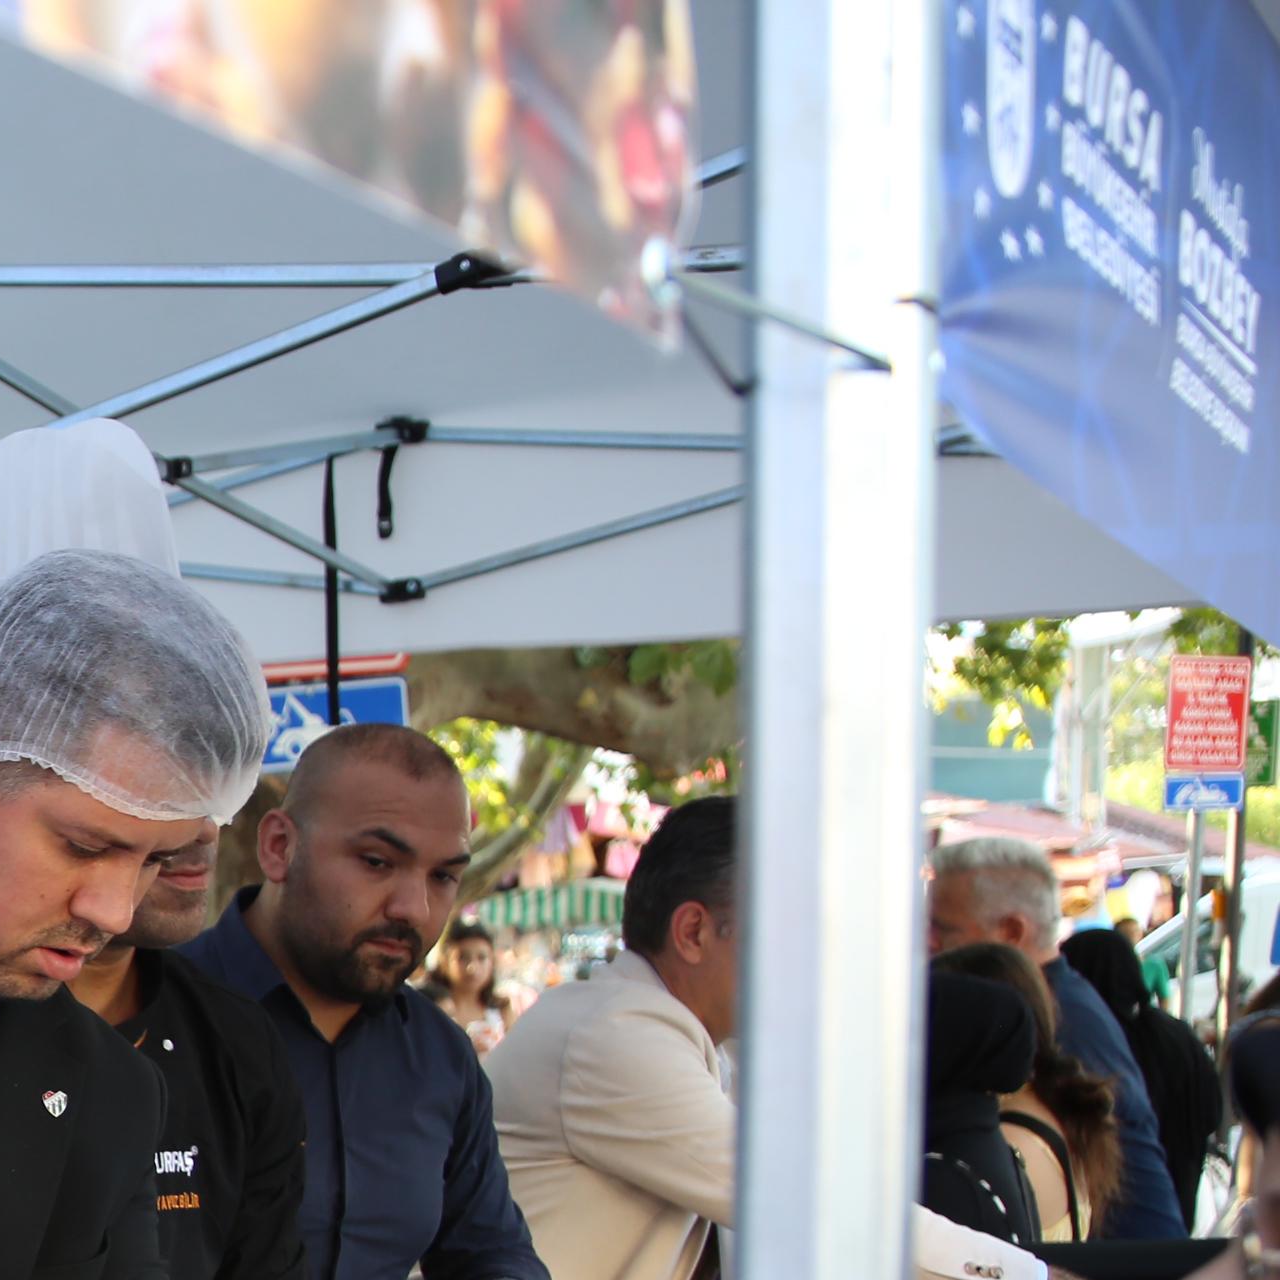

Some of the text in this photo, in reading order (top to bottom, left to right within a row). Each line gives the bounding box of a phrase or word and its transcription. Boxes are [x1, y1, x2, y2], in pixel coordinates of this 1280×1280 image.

[1062, 14, 1163, 192] BURSA
[1178, 208, 1261, 355] BOZBEY
[154, 1150, 195, 1177] URFAŞ
